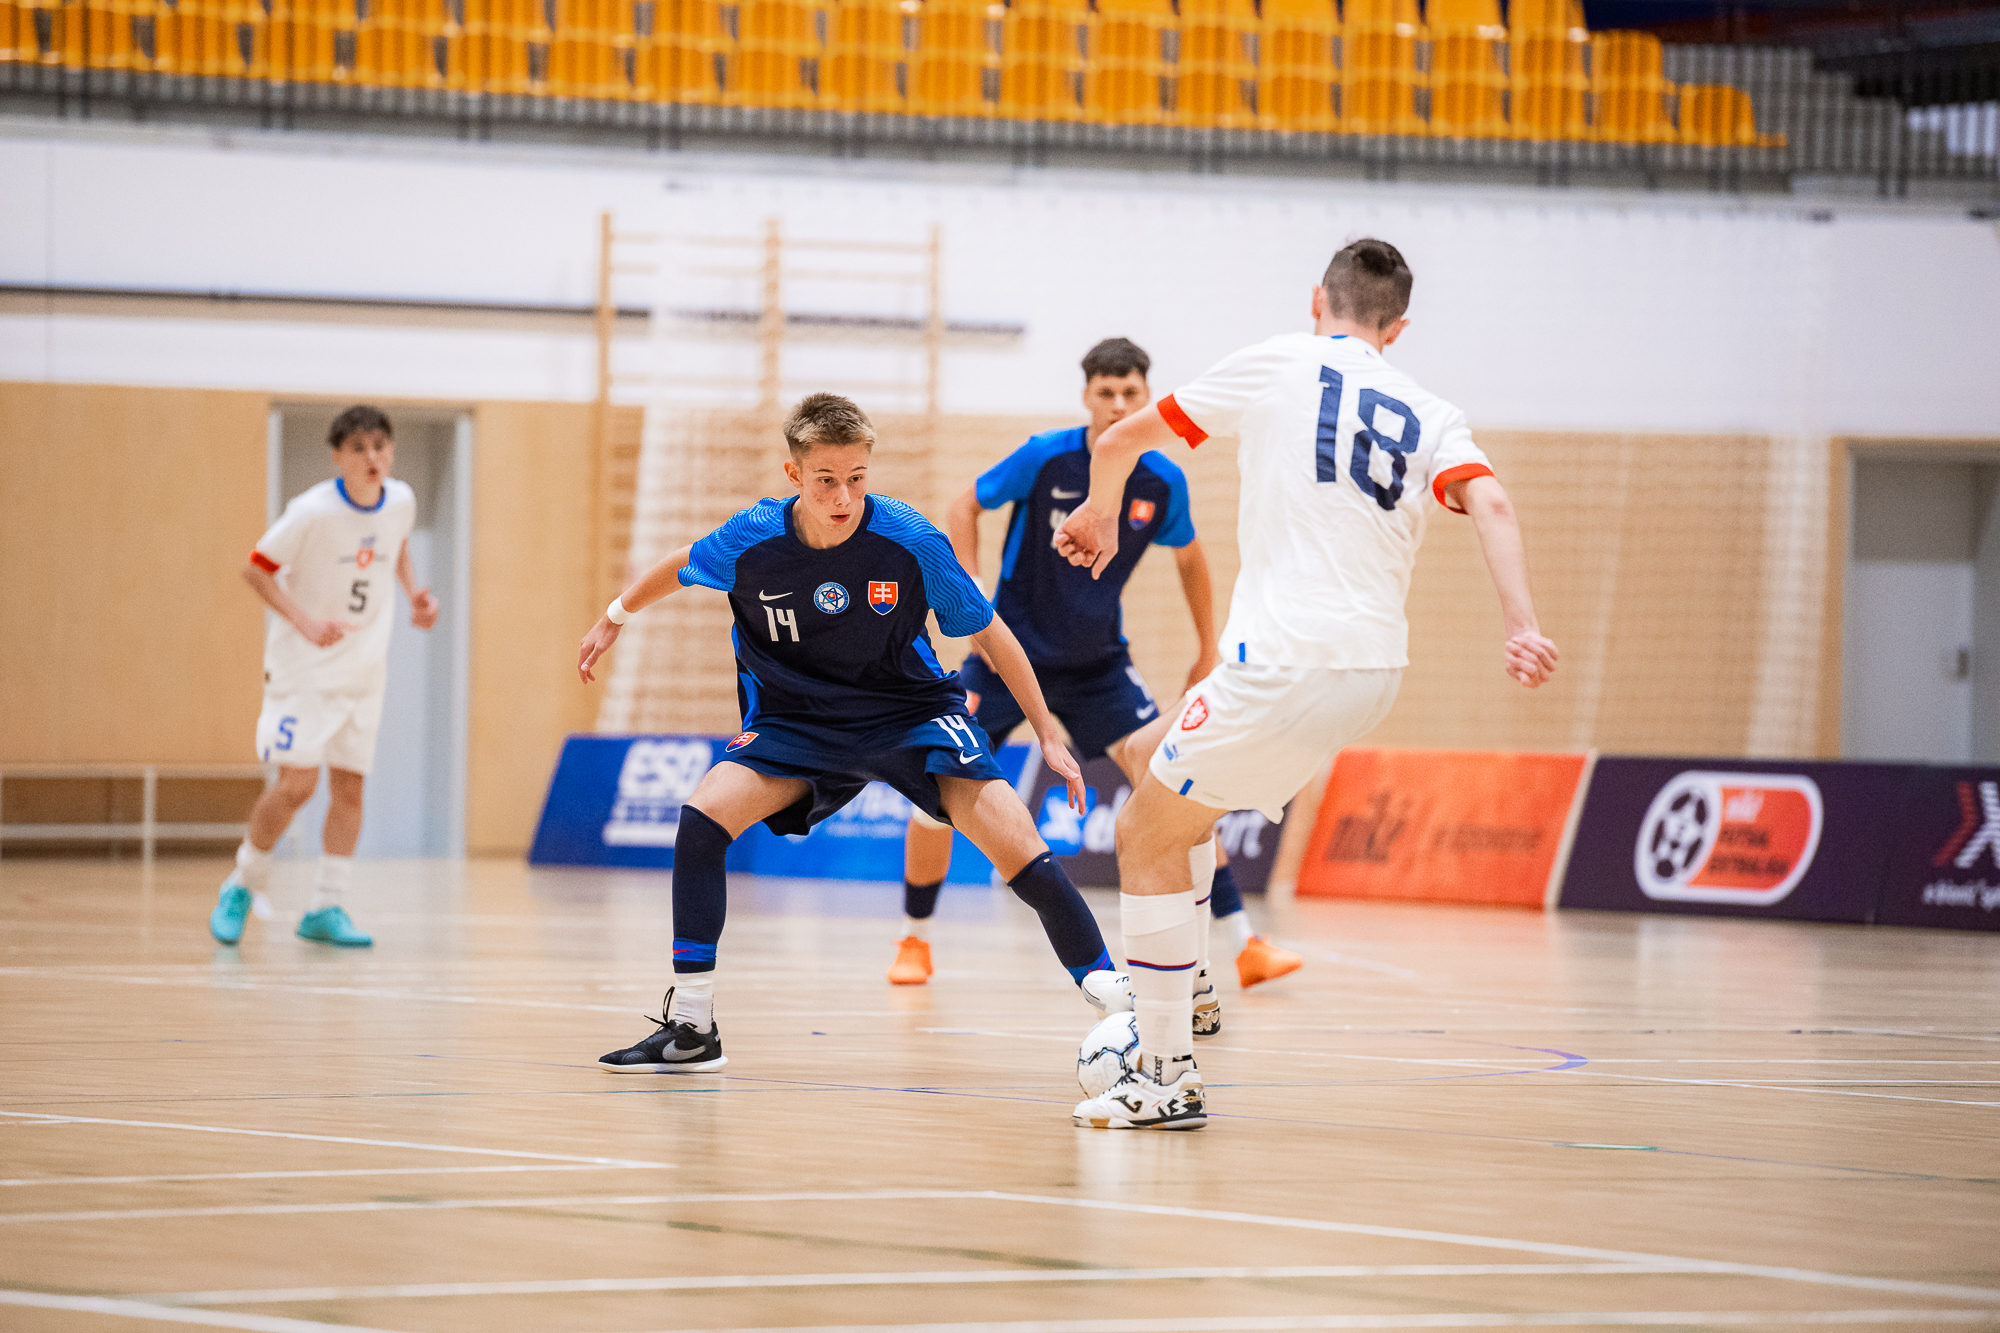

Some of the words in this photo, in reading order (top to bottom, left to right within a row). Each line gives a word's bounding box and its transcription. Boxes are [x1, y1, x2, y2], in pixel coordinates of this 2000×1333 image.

[1316, 364, 1421, 511] 18
[348, 580, 369, 613] 5
[762, 605, 800, 642] 14
[275, 716, 298, 751] 5
[931, 714, 980, 748] 14
